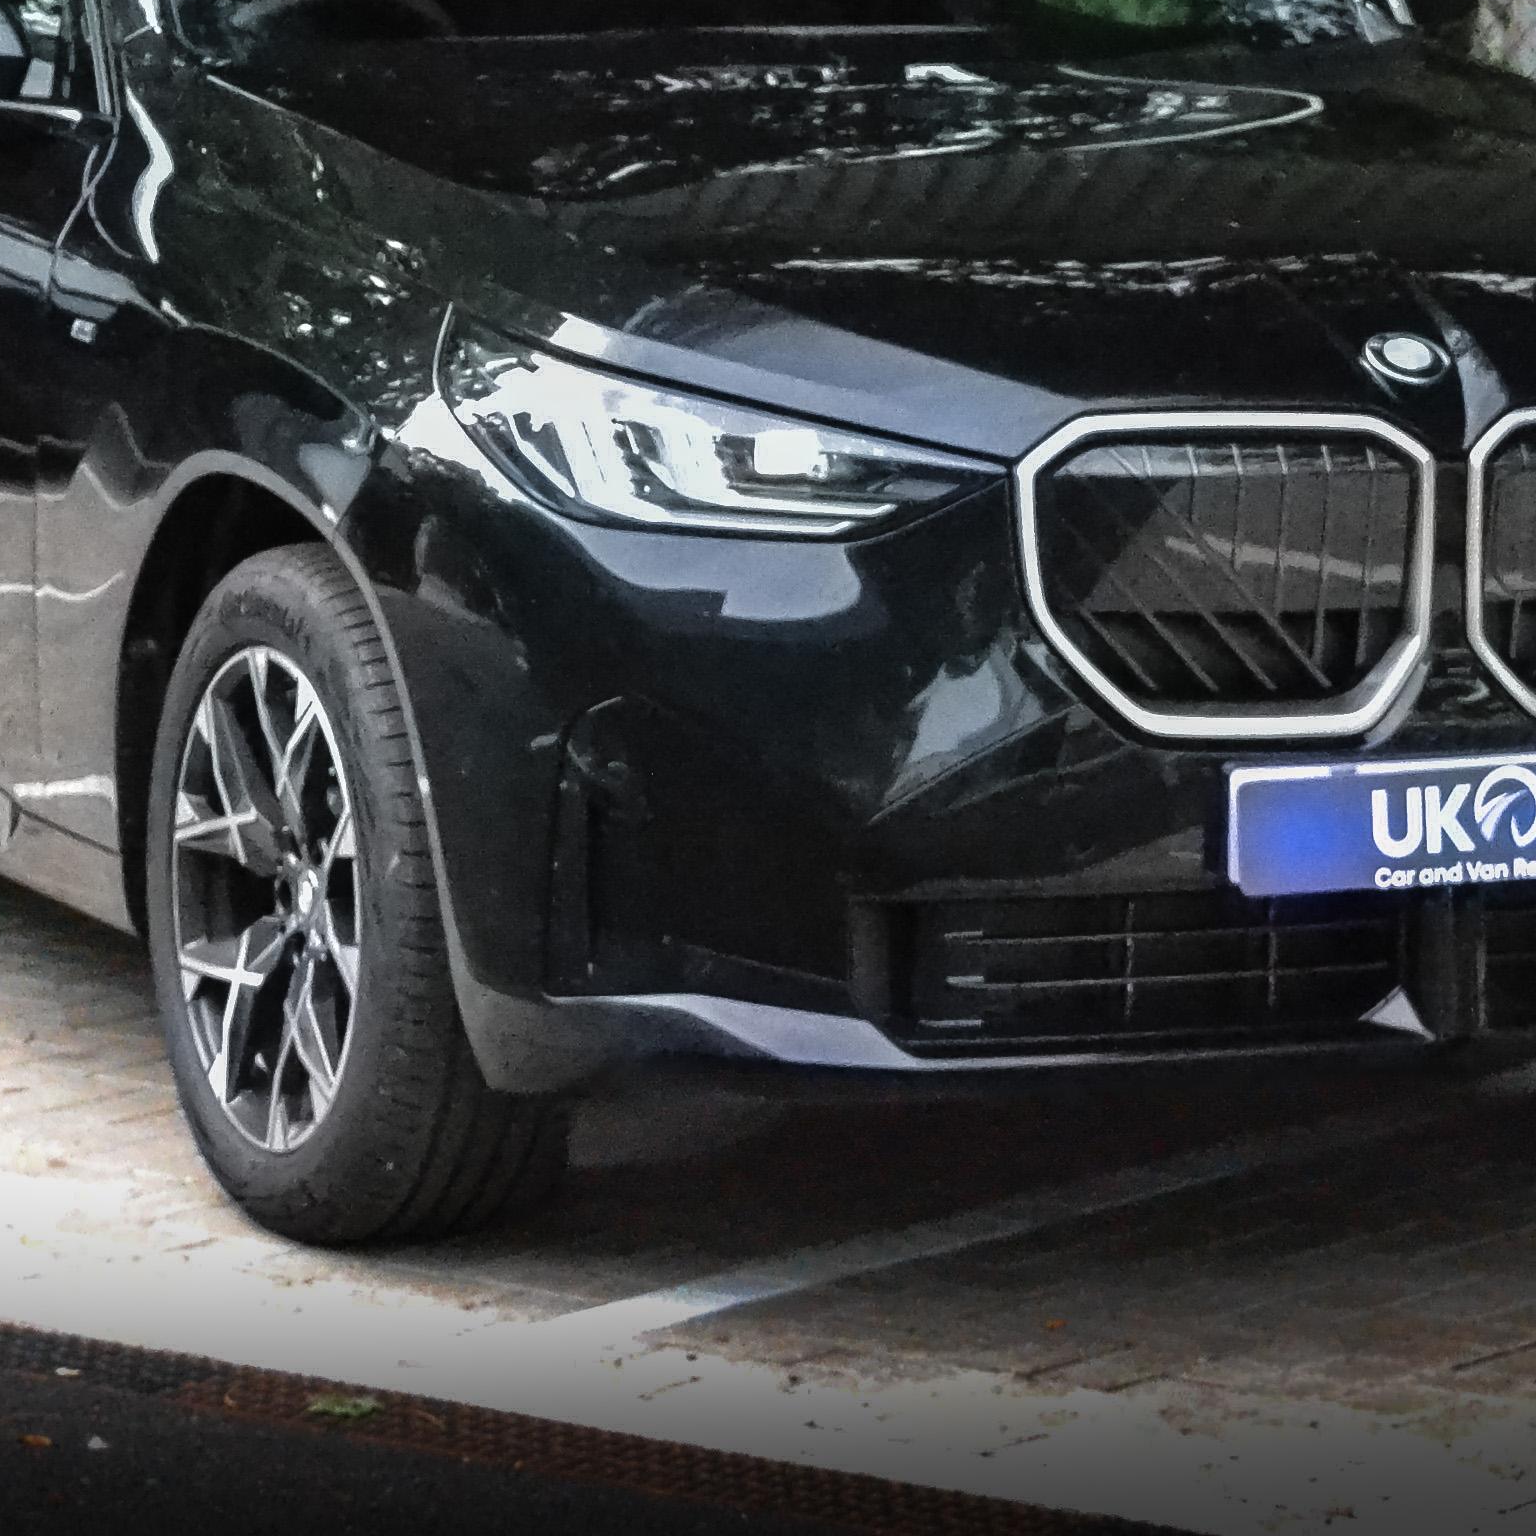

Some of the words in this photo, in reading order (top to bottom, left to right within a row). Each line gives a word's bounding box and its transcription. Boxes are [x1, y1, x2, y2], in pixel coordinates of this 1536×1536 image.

[1371, 783, 1475, 858] UK
[1374, 866, 1416, 888] Car
[1418, 861, 1464, 885] and
[1466, 861, 1509, 881] Van
